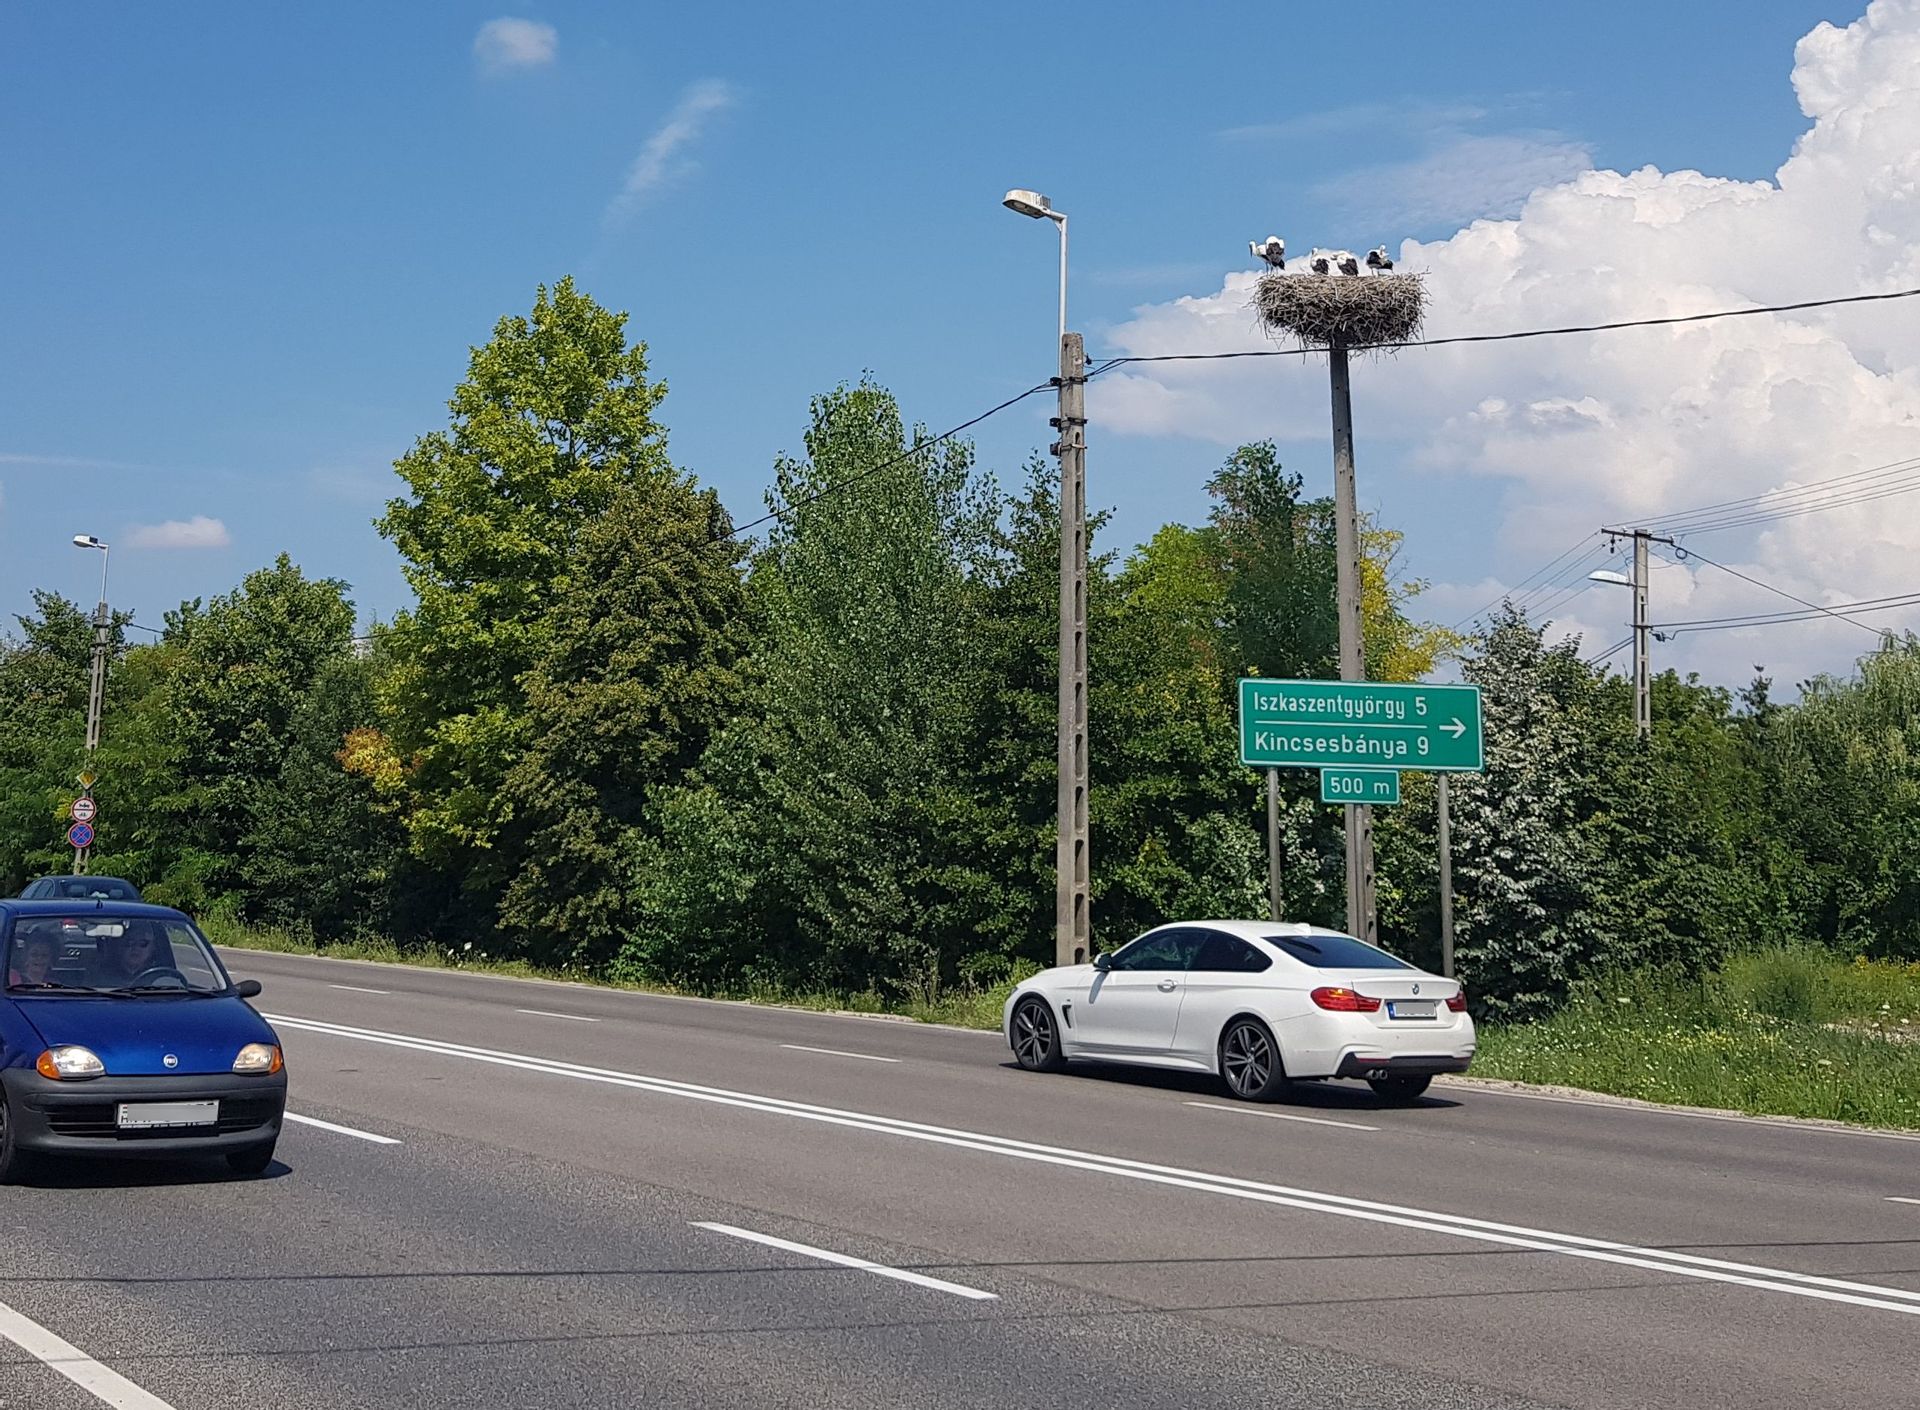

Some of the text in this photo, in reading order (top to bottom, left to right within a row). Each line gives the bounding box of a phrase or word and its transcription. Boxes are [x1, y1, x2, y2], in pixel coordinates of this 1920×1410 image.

[1254, 692, 1427, 719] Iszkaszentgyörgy 5
[1255, 732, 1429, 758] Kincsesbánya 9
[1331, 777, 1390, 794] 500 m
